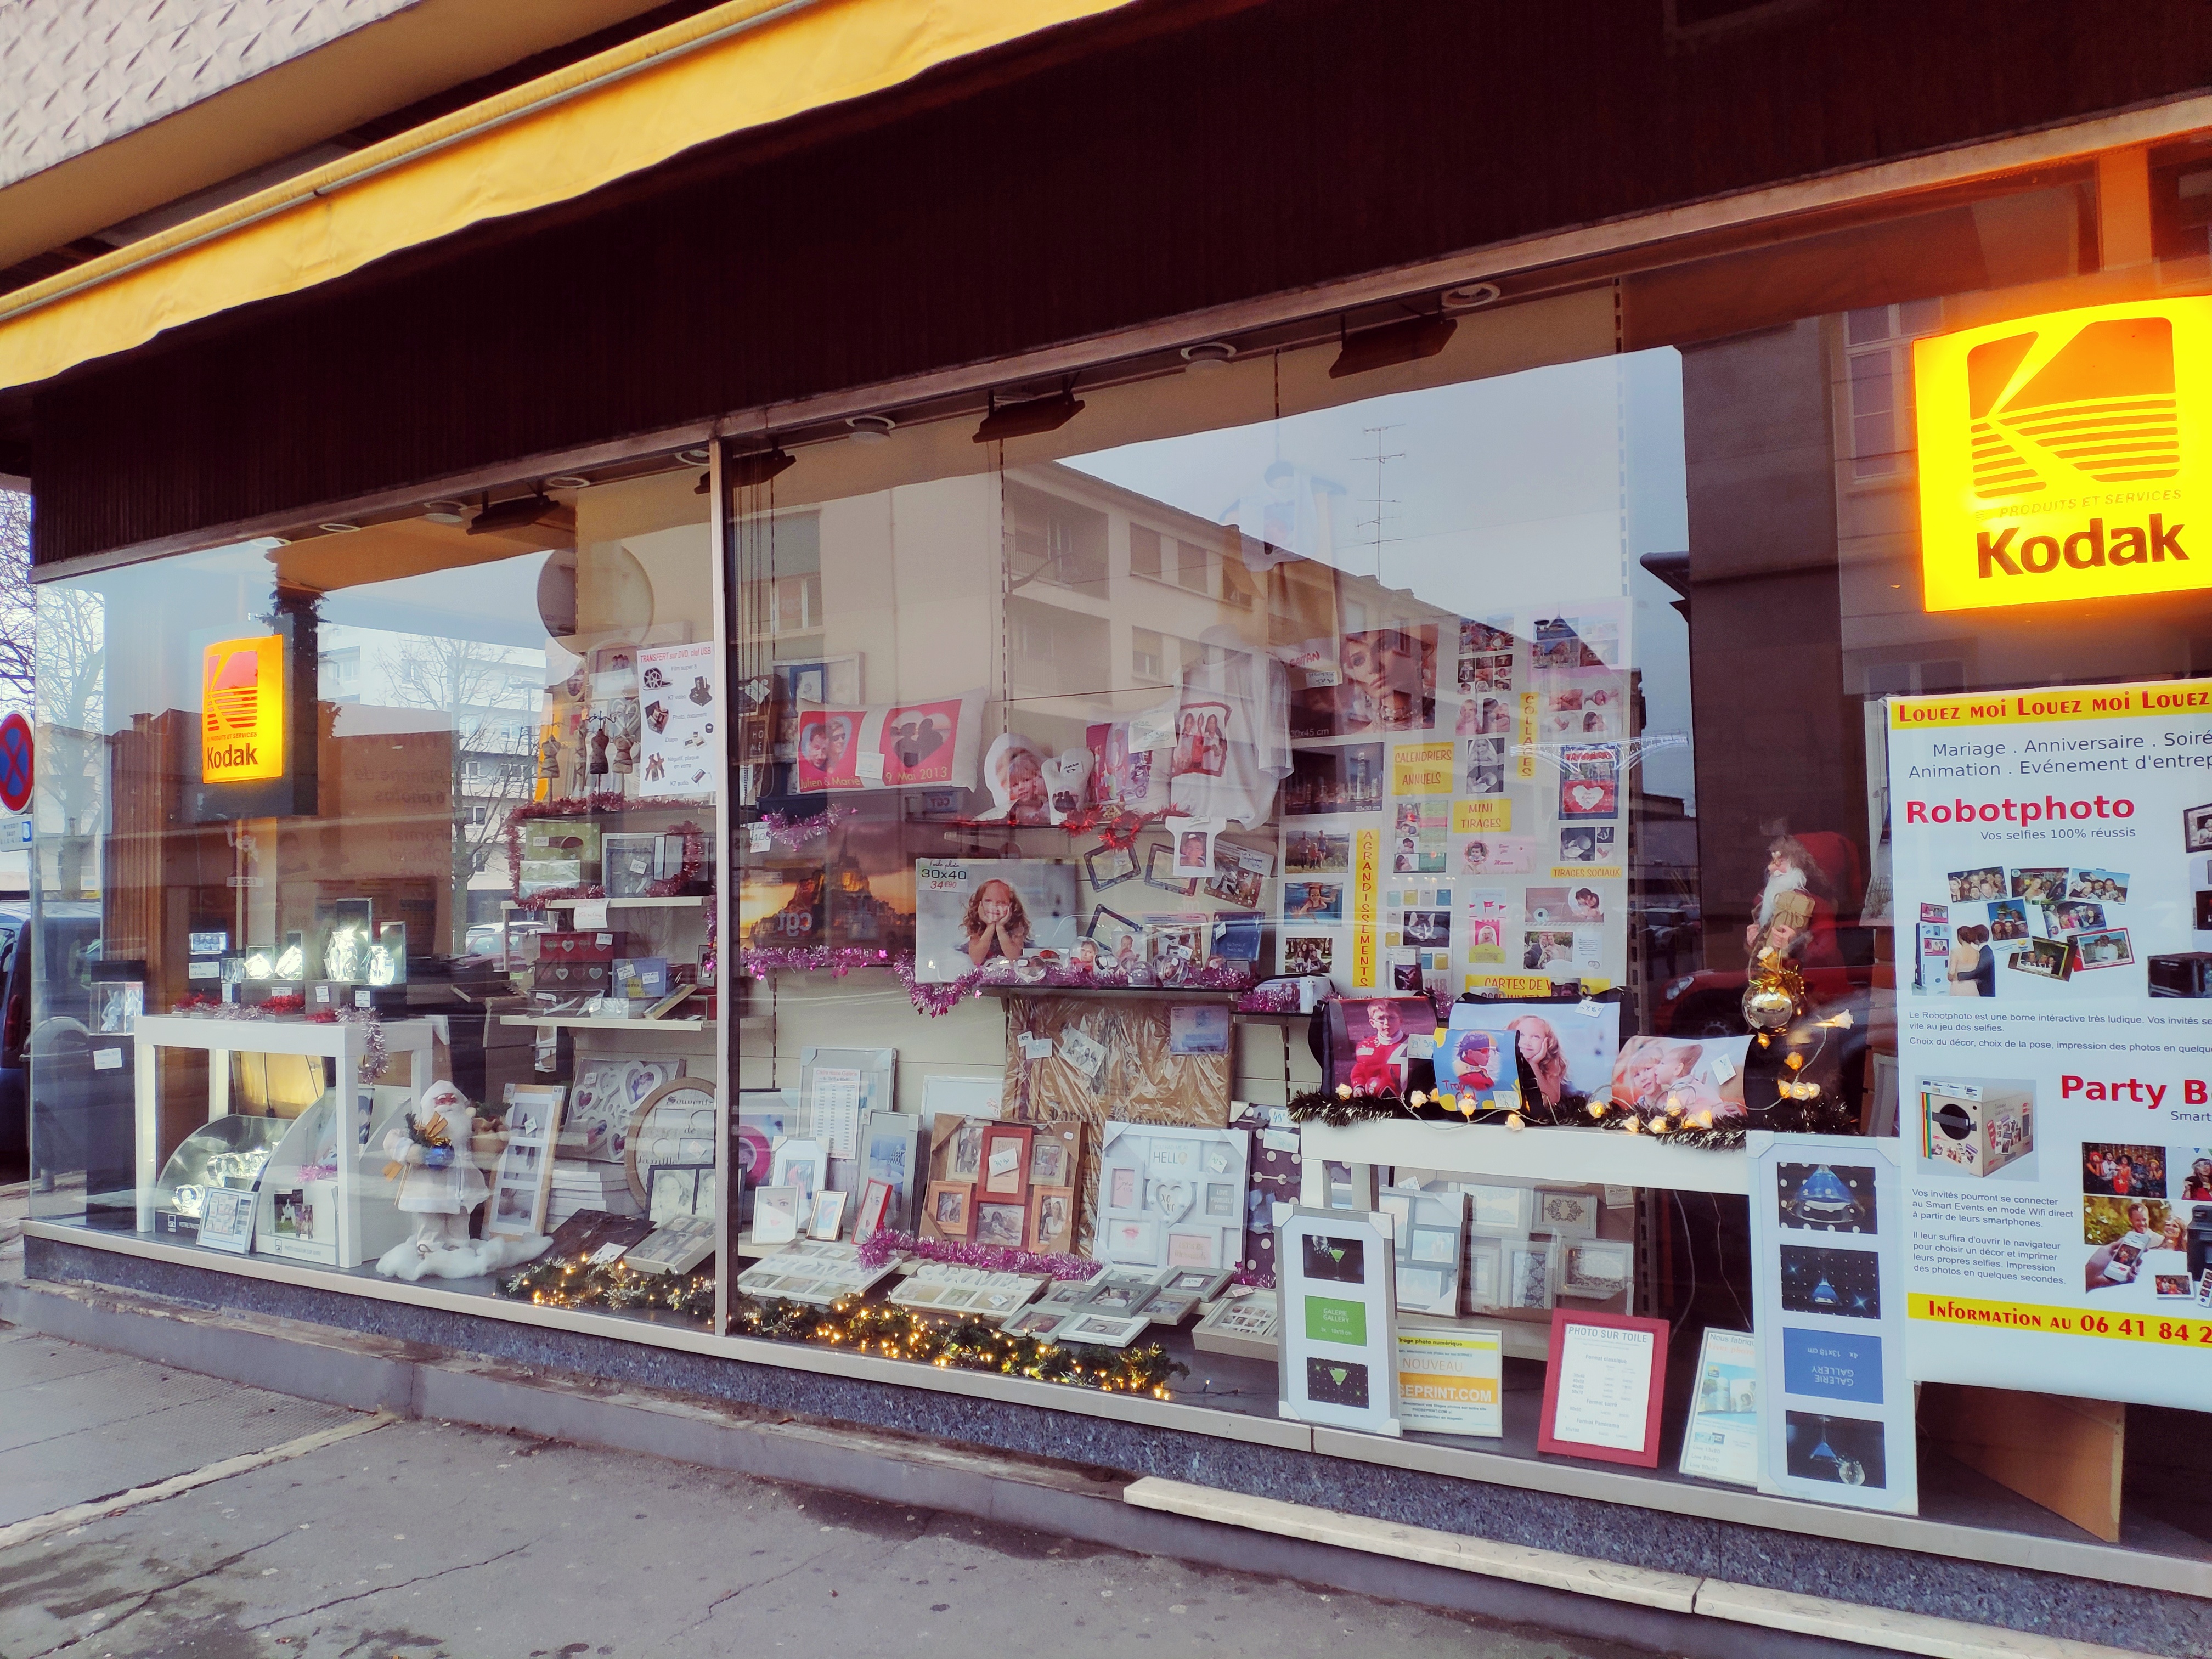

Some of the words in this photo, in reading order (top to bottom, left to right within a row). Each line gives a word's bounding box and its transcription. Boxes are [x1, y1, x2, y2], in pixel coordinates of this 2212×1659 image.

[2000, 499, 2076, 517] PRODUITS
[2082, 496, 2100, 507] ET
[2105, 489, 2181, 505] SERVICES
[1977, 513, 2190, 579] Kodak
[641, 652, 669, 662] TRANSFERT
[691, 648, 699, 656] clef
[701, 647, 711, 655] USB
[1290, 729, 1314, 737] 30x45
[1933, 742, 2006, 758] Mariage
[2024, 735, 2144, 753] Anniversaire
[207, 743, 259, 770] Kodak
[1395, 749, 1452, 763] CALENDRIERS
[1909, 763, 2000, 778] Animation
[2021, 757, 2129, 774] Evénement
[885, 772, 892, 782] 9
[898, 772, 916, 781] Mai
[920, 767, 947, 780] 2013
[1402, 772, 1441, 785] ANNUELS
[800, 777, 822, 789] Julien
[824, 776, 830, 786] &
[832, 776, 861, 786] Marie
[1468, 803, 1493, 813] MINI
[1906, 795, 2135, 827] Robotphoto
[1460, 817, 1501, 829] TIRAGES
[1980, 831, 2002, 840] Vos
[2006, 830, 2046, 839] selfies
[2051, 829, 2086, 839] 100%
[2091, 827, 2135, 837] réussis
[922, 869, 966, 880] 30x40
[1553, 868, 1585, 877] TIRAGES
[1587, 868, 1620, 877] SOCIAUX
[1359, 831, 1372, 987] AGRANDISSEMENTS
[1485, 978, 1525, 990] CARTES
[1529, 979, 1542, 990] DE
[1922, 1012, 1972, 1020] Robotphoto
[2108, 1015, 2144, 1024] ludique.
[2147, 1016, 2165, 1024] Vos
[2168, 1017, 2199, 1025] invités
[2057, 1042, 2107, 1051] impression
[2130, 1043, 2160, 1052] photos
[2179, 1045, 2212, 1054] quelqu
[2062, 1075, 2167, 1110] Party
[2184, 1079, 2212, 1104] B
[2171, 1110, 2211, 1121] Smart
[684, 1125, 696, 1134] de
[1161, 1194, 1171, 1203] XO
[1912, 1188, 1928, 1197] Vos
[1931, 1190, 1959, 1199] invités
[1961, 1193, 1998, 1202] pourront
[2014, 1196, 2058, 1205] connecter
[1926, 1200, 1952, 1210] Smart
[1955, 1203, 1984, 1212] Events
[2001, 1206, 2026, 1215] mode
[2028, 1207, 2045, 1216] Wifi
[2049, 1209, 2074, 1218] direct
[1959, 1214, 1980, 1223] leurs
[1983, 1217, 2043, 1227] smartphones.
[1920, 1232, 1937, 1240] leur
[1939, 1233, 1965, 1243] suffira
[1968, 1235, 2000, 1245] d'ouvrir
[2014, 1240, 2061, 1250] navigateur
[1323, 1308, 1347, 1317] GALERIE
[1323, 1314, 1349, 1323] GALLERY
[2081, 1315, 2109, 1333] 06
[2118, 1319, 2145, 1336] 41
[2159, 1322, 2189, 1341] 84
[1568, 1327, 1598, 1337] PHOTO
[1601, 1330, 1619, 1340] SUR
[1622, 1333, 1647, 1343] TOILE
[1710, 1333, 1729, 1342] Nous
[1820, 1348, 1841, 1357] 13x18
[1403, 1358, 1463, 1372] NOUVEAU
[1811, 1365, 1854, 1377] GALLERY
[1814, 1374, 1853, 1386] GALERIE
[1595, 1420, 1620, 1429] Panorama
